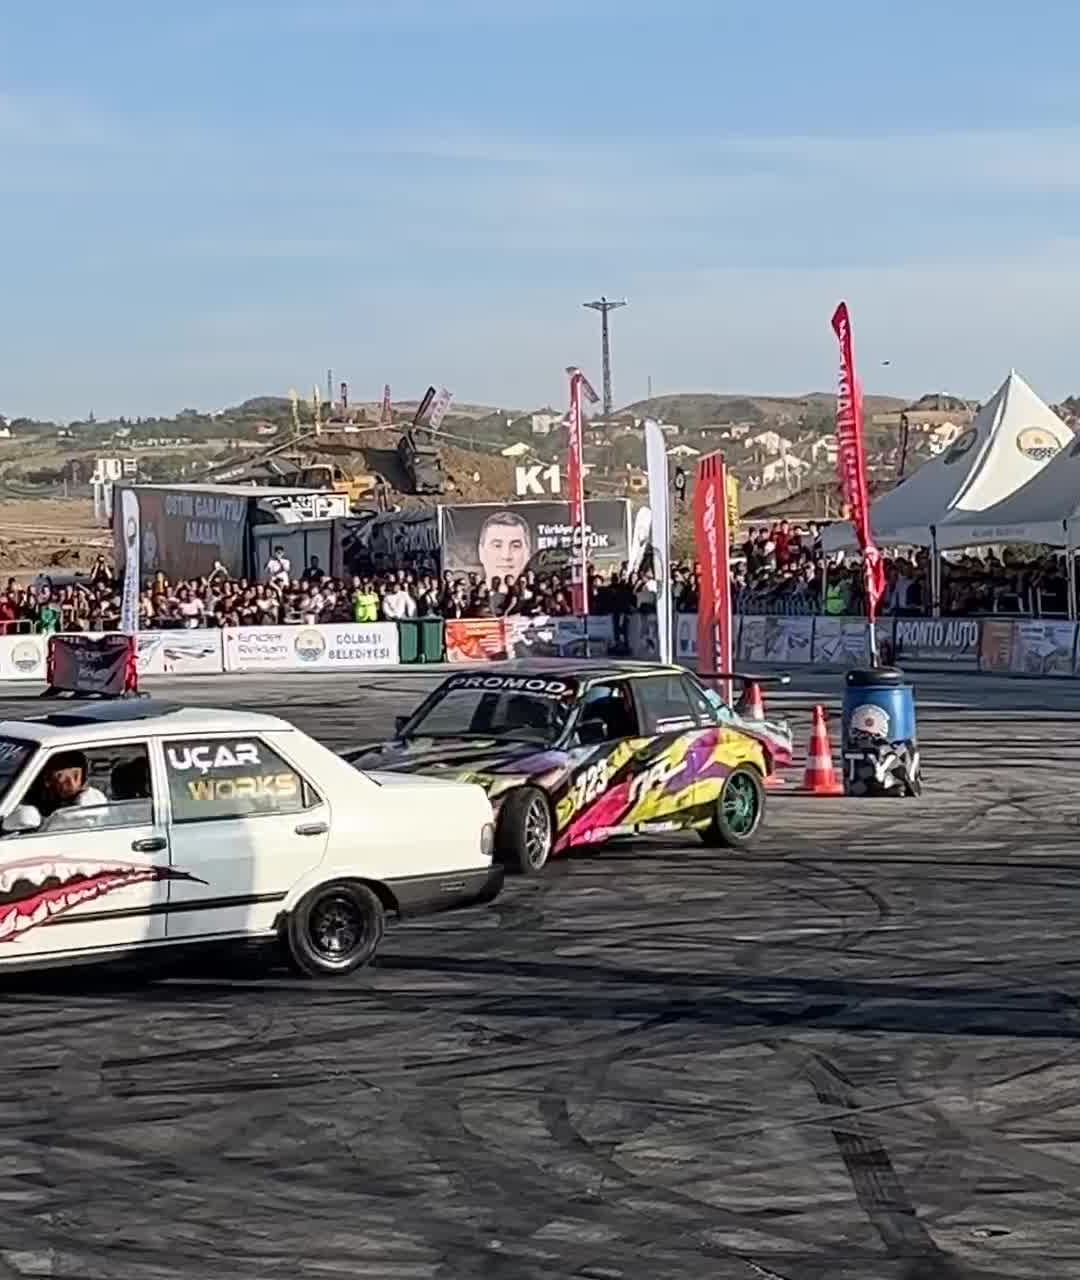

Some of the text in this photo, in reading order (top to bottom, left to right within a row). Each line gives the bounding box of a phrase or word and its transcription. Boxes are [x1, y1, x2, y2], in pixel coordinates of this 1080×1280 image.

[515, 465, 561, 496] K1
[896, 621, 943, 646] PRONTO
[448, 676, 567, 693] PROMOD
[168, 742, 261, 774] UÇAR
[188, 773, 297, 801] WORKS
